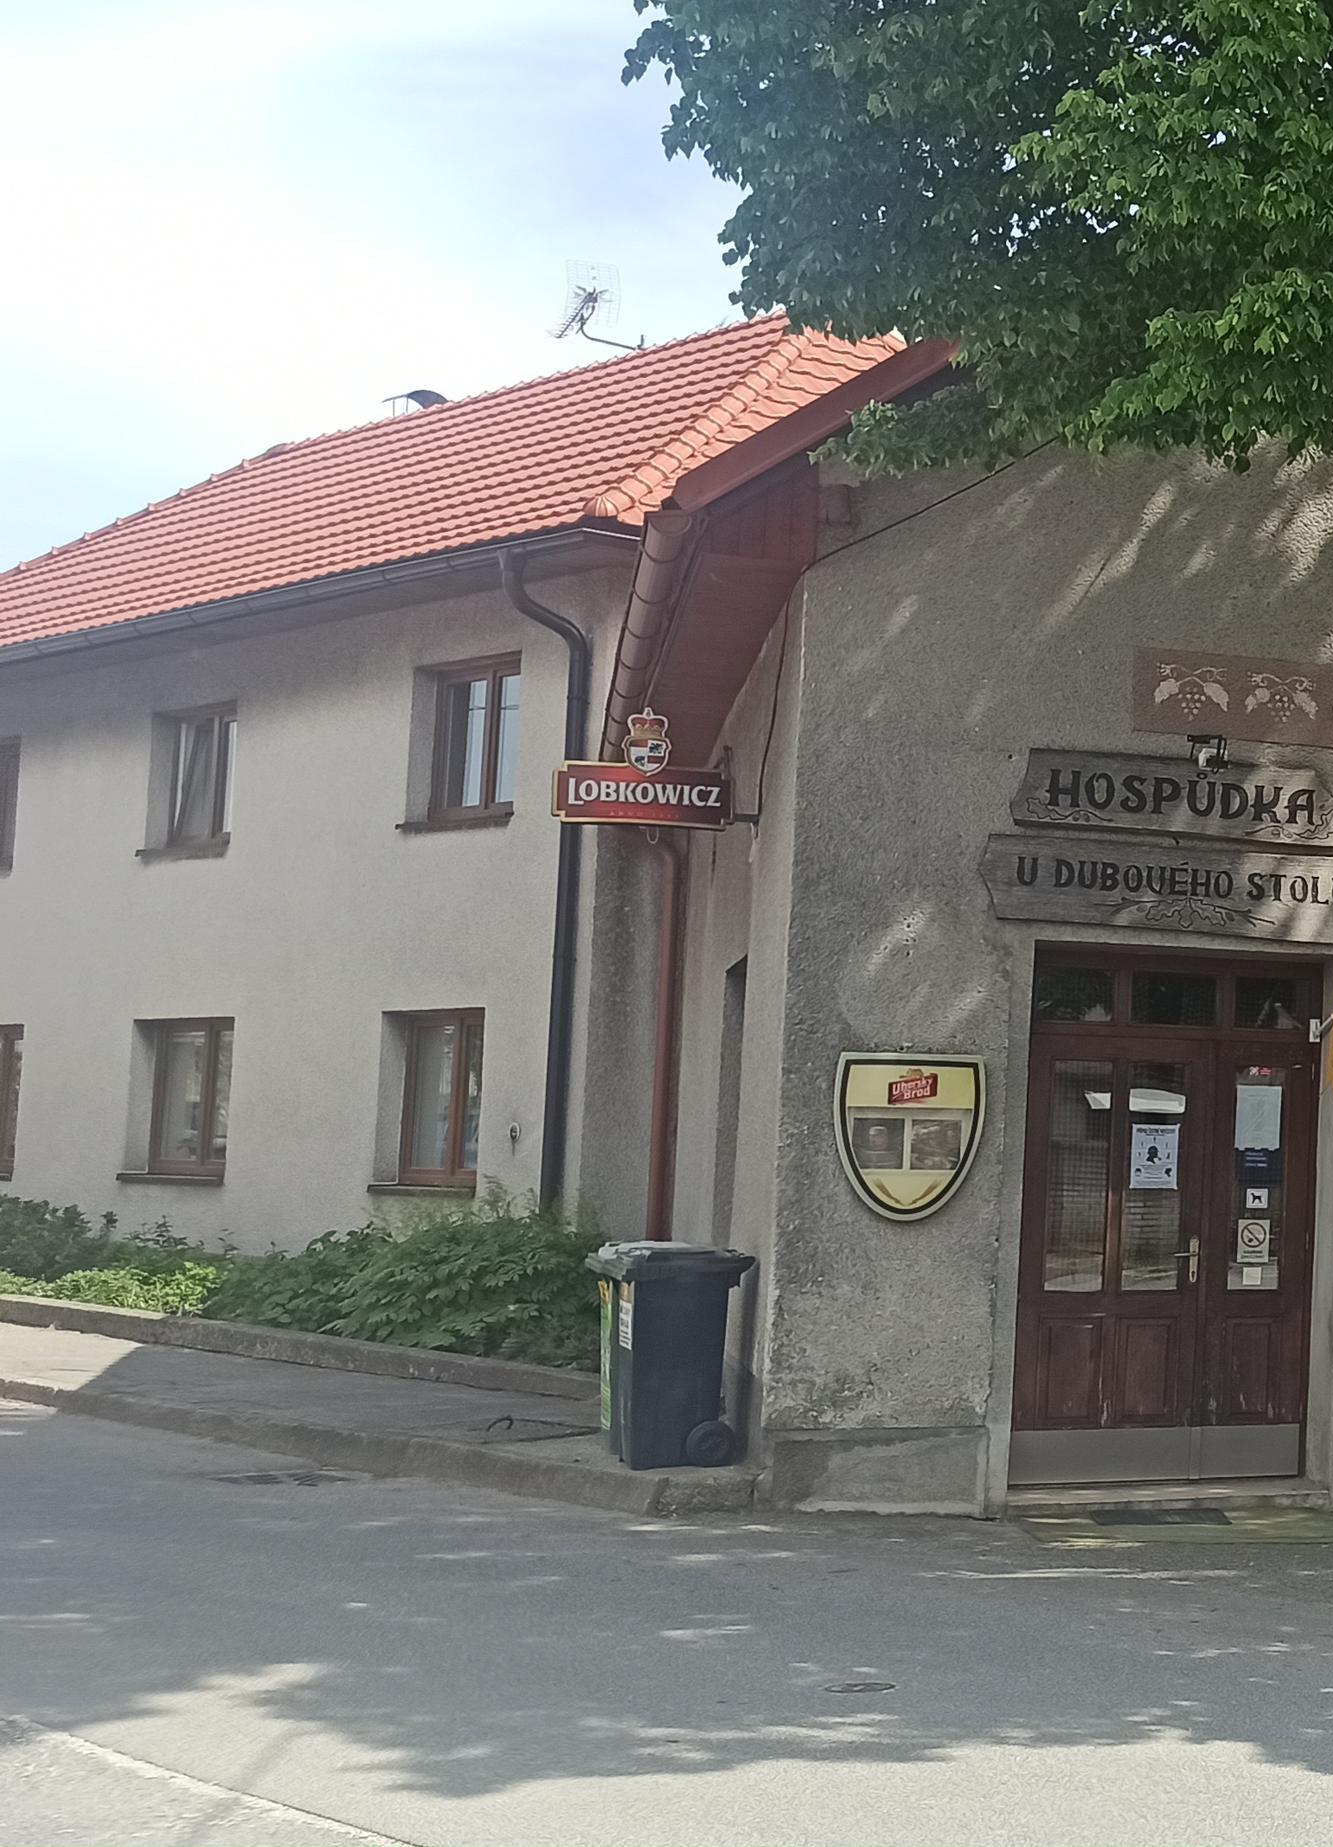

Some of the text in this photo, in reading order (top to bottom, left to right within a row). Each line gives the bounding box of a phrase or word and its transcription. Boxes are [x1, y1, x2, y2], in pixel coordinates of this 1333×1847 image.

[567, 777, 721, 807] LOBKOWICZ
[1046, 768, 1316, 826] HOSPŮDKA
[1016, 856, 1039, 886] U
